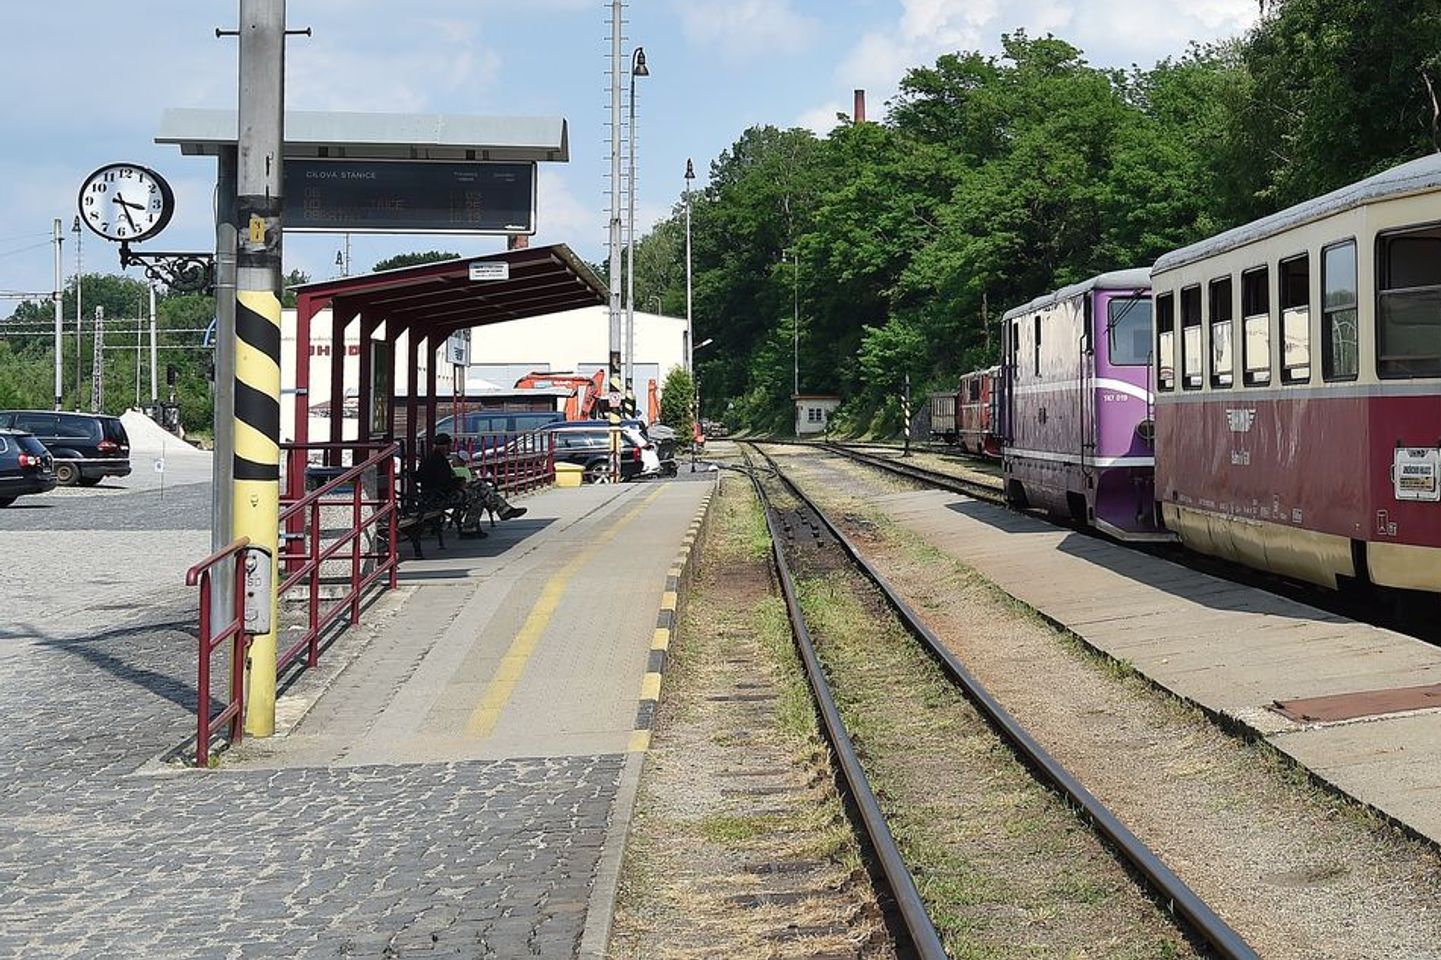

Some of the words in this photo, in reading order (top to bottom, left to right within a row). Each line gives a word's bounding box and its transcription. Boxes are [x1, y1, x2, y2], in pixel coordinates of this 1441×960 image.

[104, 172, 115, 182] 11
[120, 168, 133, 179] 12
[139, 173, 144, 183] 1
[92, 183, 107, 193] 10
[148, 183, 157, 194] 2
[85, 196, 94, 206] 9
[152, 199, 161, 209] 3
[102, 222, 110, 232] 7
[117, 226, 126, 237] 6
